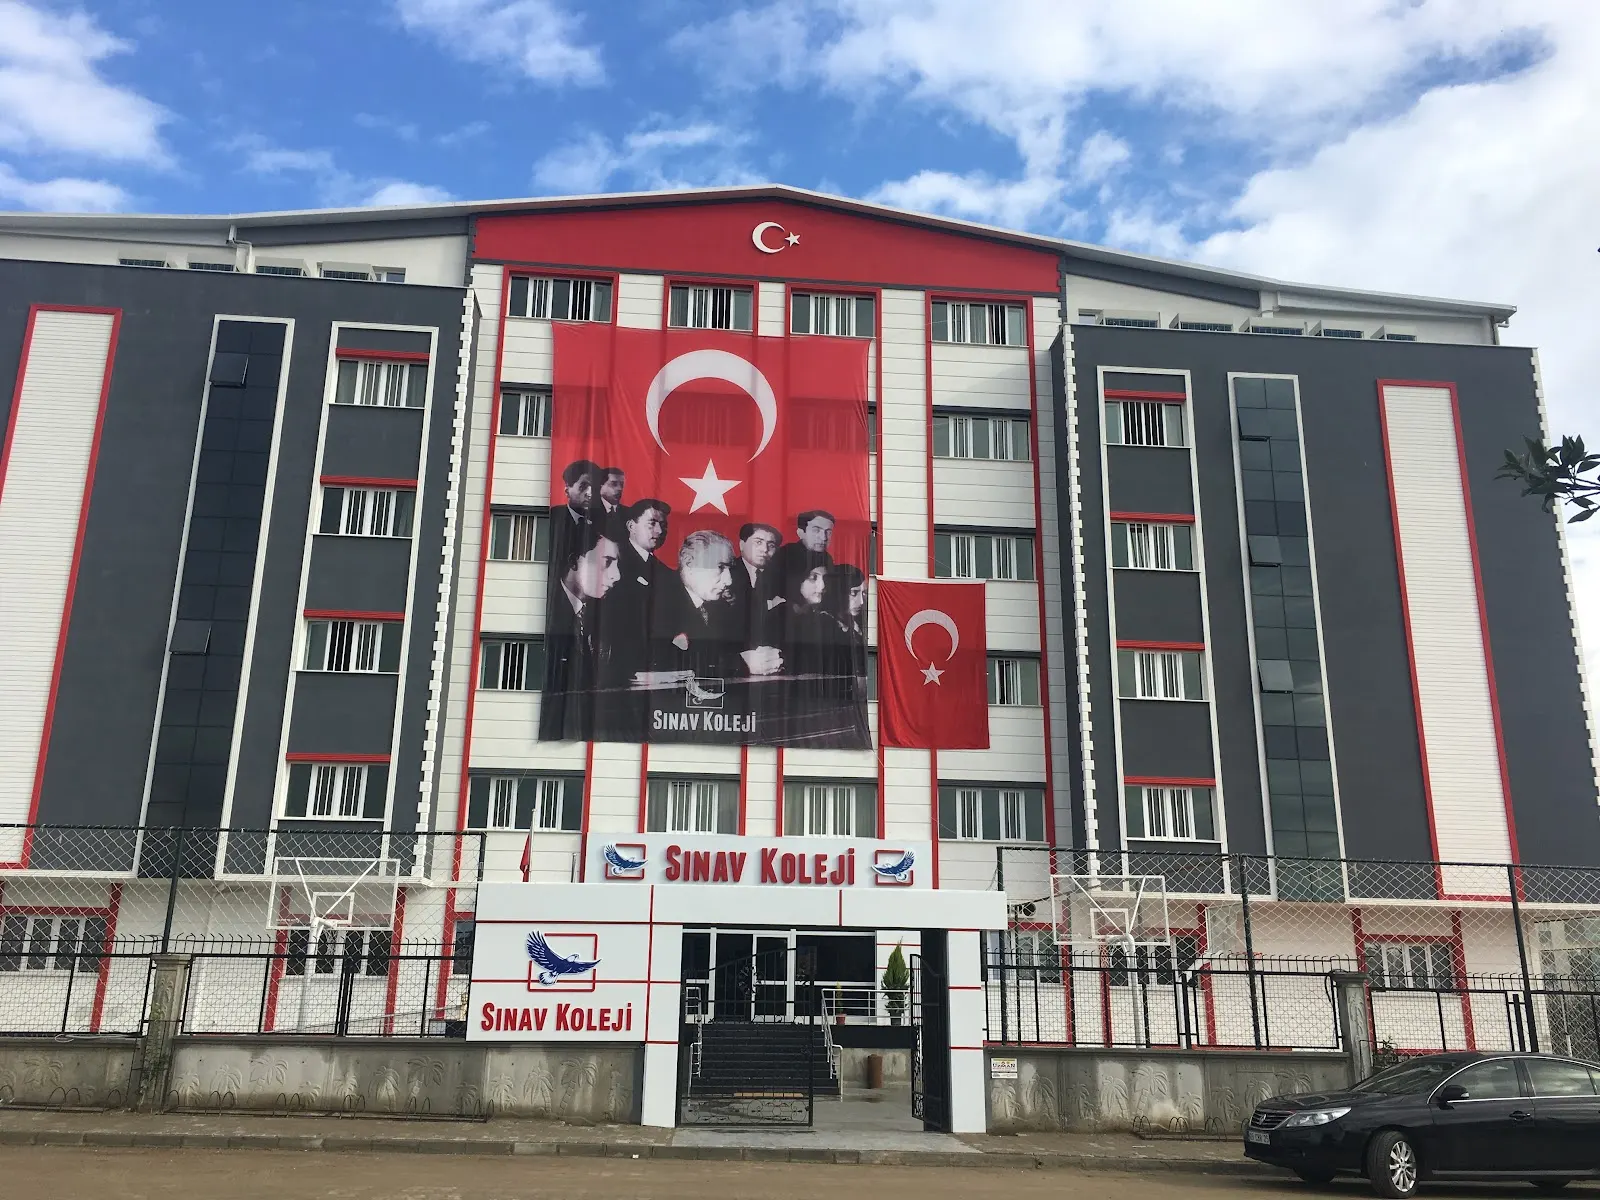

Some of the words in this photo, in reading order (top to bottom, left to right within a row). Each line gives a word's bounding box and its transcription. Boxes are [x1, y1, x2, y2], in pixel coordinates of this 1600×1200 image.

[653, 710, 700, 731] SINAV
[665, 845, 747, 883] SINAV
[481, 1002, 548, 1032] SINAV
